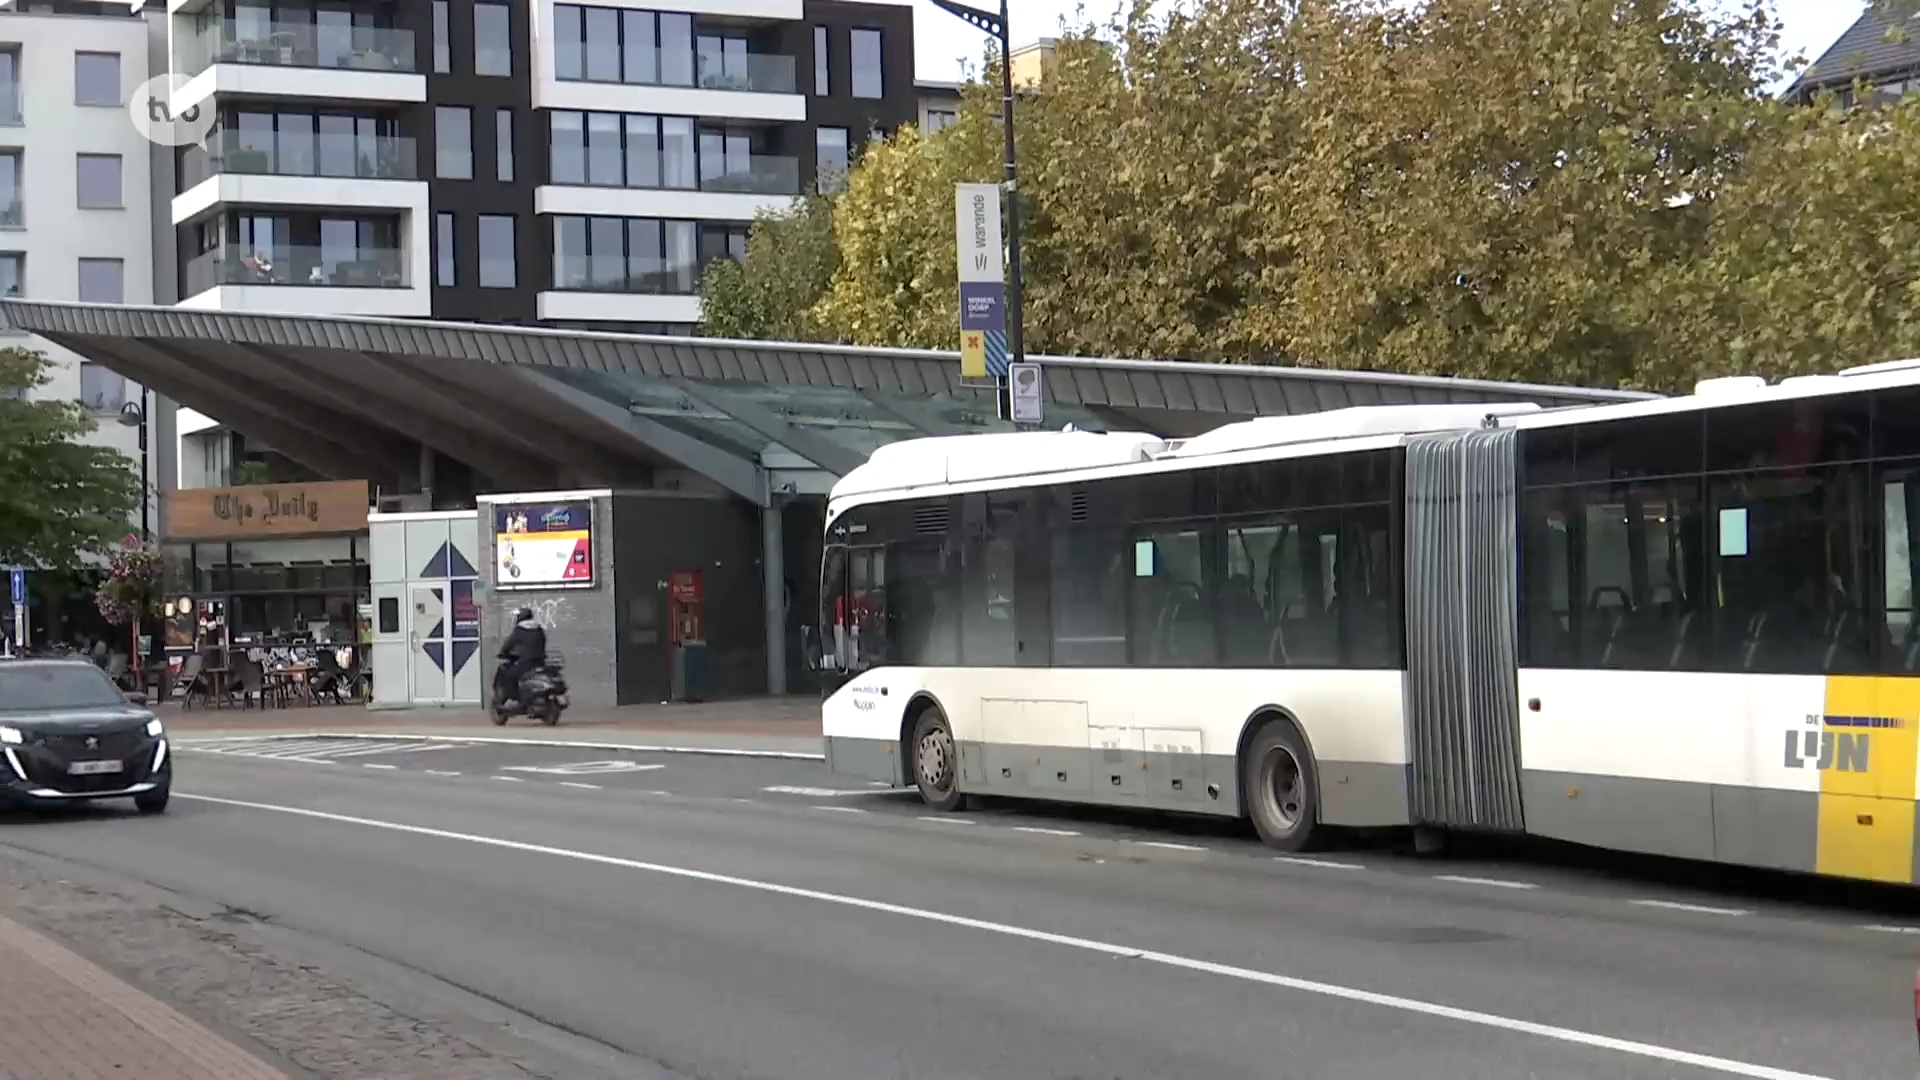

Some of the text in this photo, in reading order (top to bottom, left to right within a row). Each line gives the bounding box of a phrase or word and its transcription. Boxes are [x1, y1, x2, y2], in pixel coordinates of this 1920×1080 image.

[973, 194, 987, 248] warande
[213, 488, 318, 526] The Daily
[1805, 714, 1820, 725] DE
